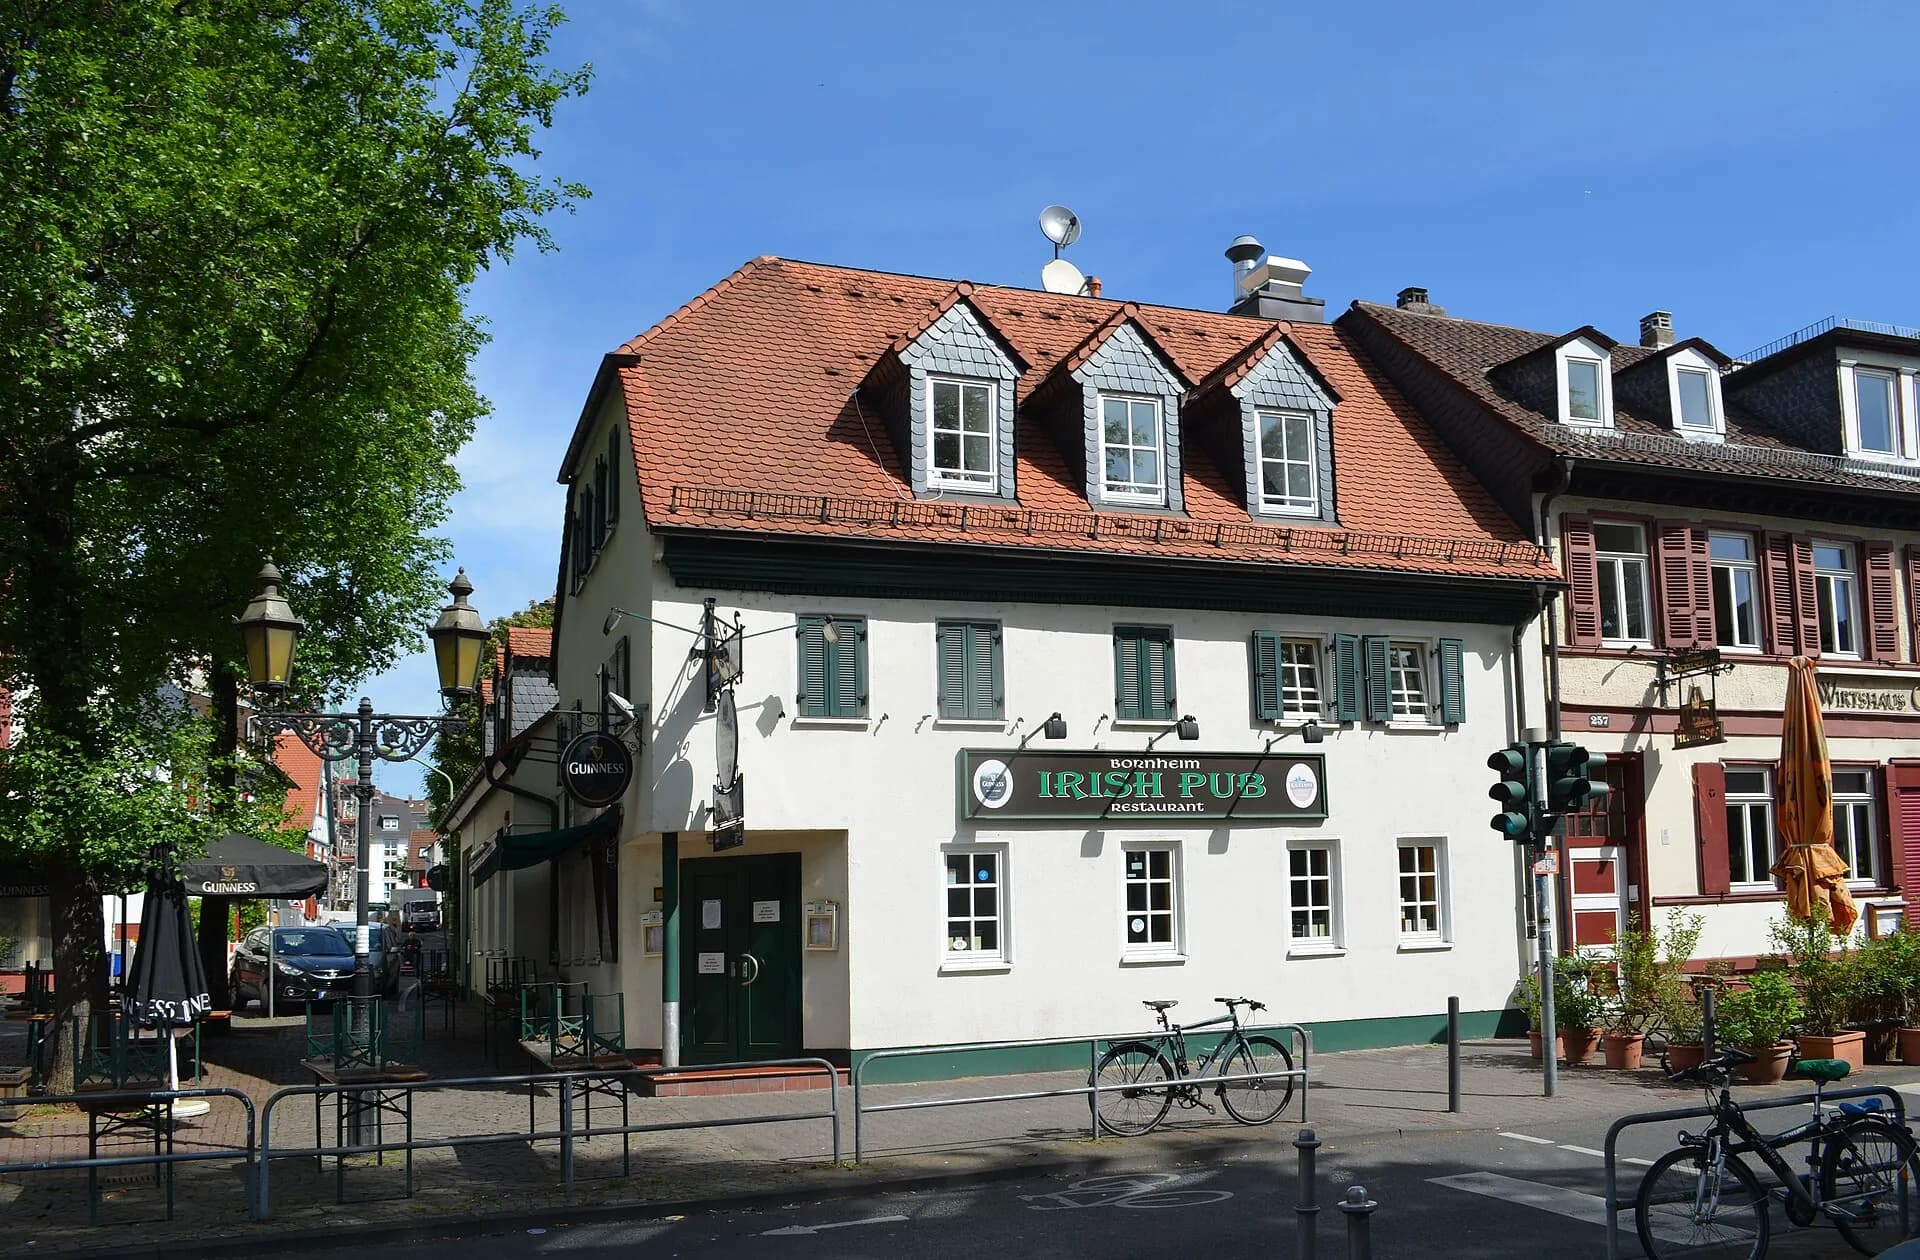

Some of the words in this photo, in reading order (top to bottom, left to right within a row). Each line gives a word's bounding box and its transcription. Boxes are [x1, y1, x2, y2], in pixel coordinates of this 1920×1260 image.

[1817, 681, 1906, 711] WIRTSHAUS
[1590, 715, 1609, 725] 257
[569, 761, 625, 775] GUINNESS
[1110, 758, 1200, 769] Bornheim
[1037, 770, 1165, 800] IRISH
[1178, 771, 1267, 799] PUB
[1111, 801, 1204, 813] Restaurant
[201, 881, 257, 893] GUINNESS
